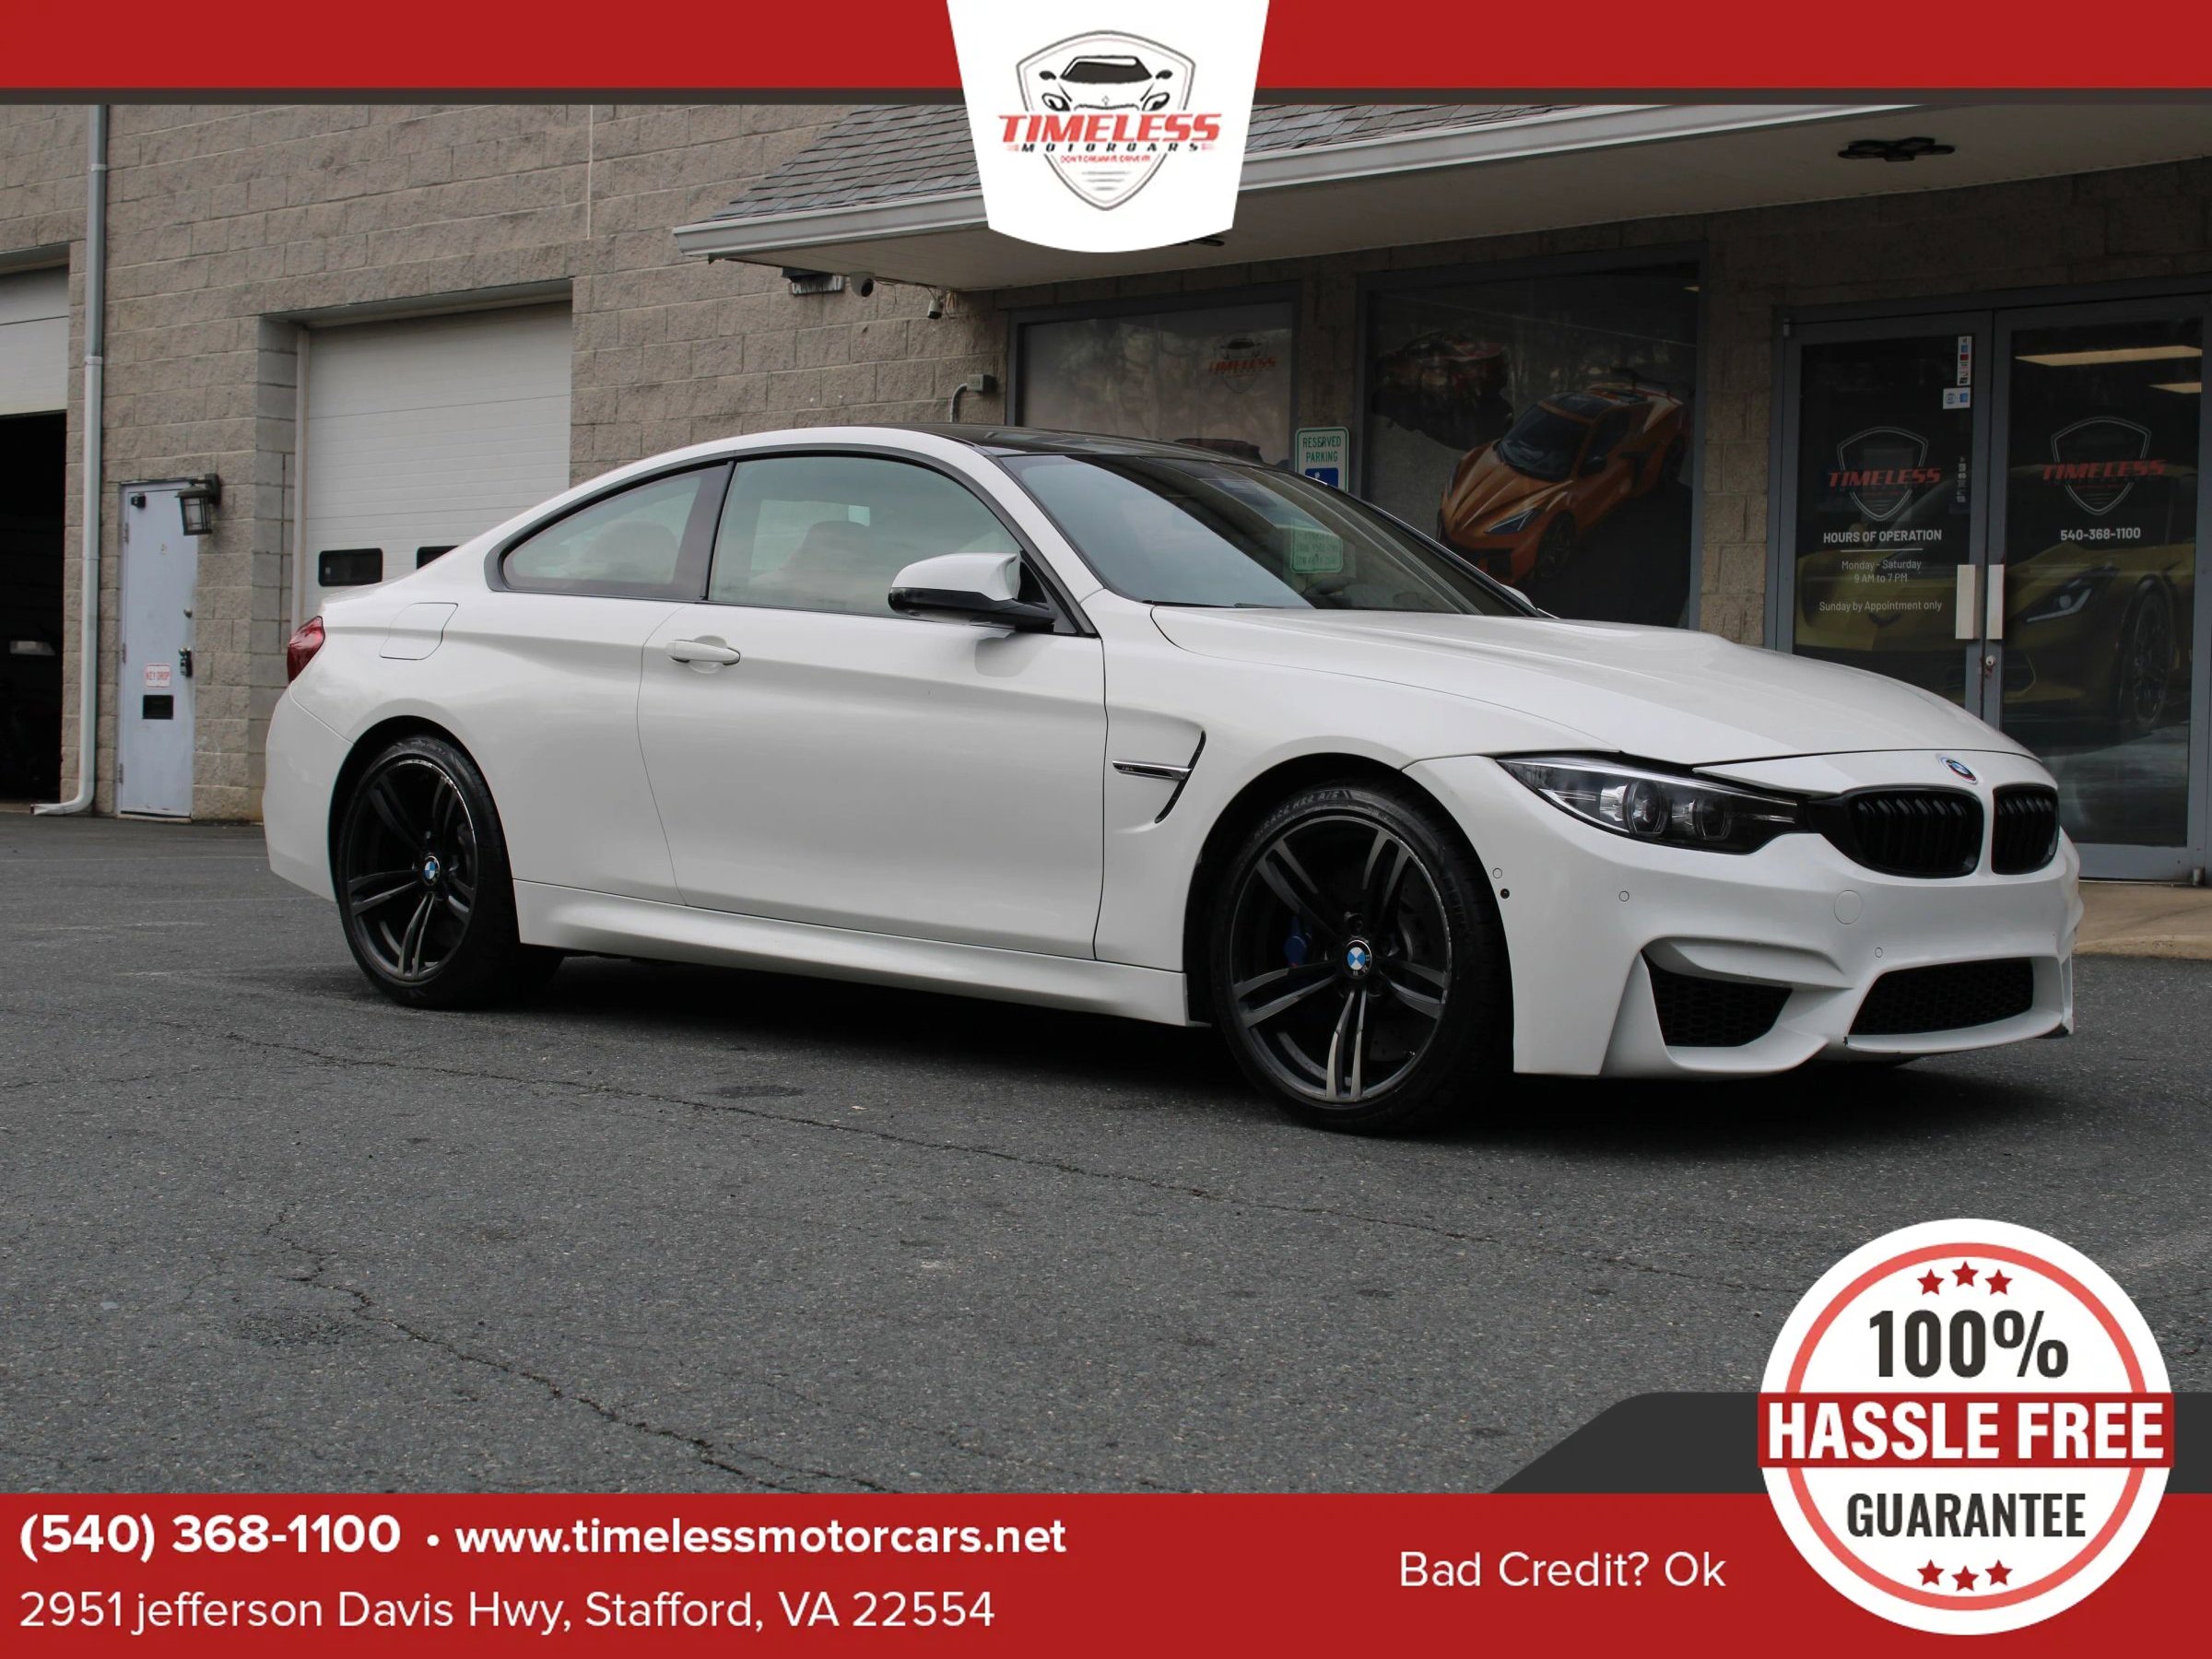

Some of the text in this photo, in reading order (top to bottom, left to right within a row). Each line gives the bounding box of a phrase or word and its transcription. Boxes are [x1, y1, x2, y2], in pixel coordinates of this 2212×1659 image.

[1302, 436, 1342, 449] RESERVED
[1306, 452, 1338, 464] PARKING
[2043, 459, 2167, 480] TIMELESS
[1829, 467, 1941, 487] TIMELESS
[1824, 530, 1942, 543] HOURS OF OPERATION
[2059, 527, 2141, 542] 540-368-1100
[1841, 560, 1875, 571] Monday
[1882, 560, 1922, 571] Saturday
[1854, 574, 1860, 583] 9
[1862, 574, 1875, 582] AM
[1895, 573, 1908, 582] PM
[1819, 601, 1942, 613] Sunday by Appointment only
